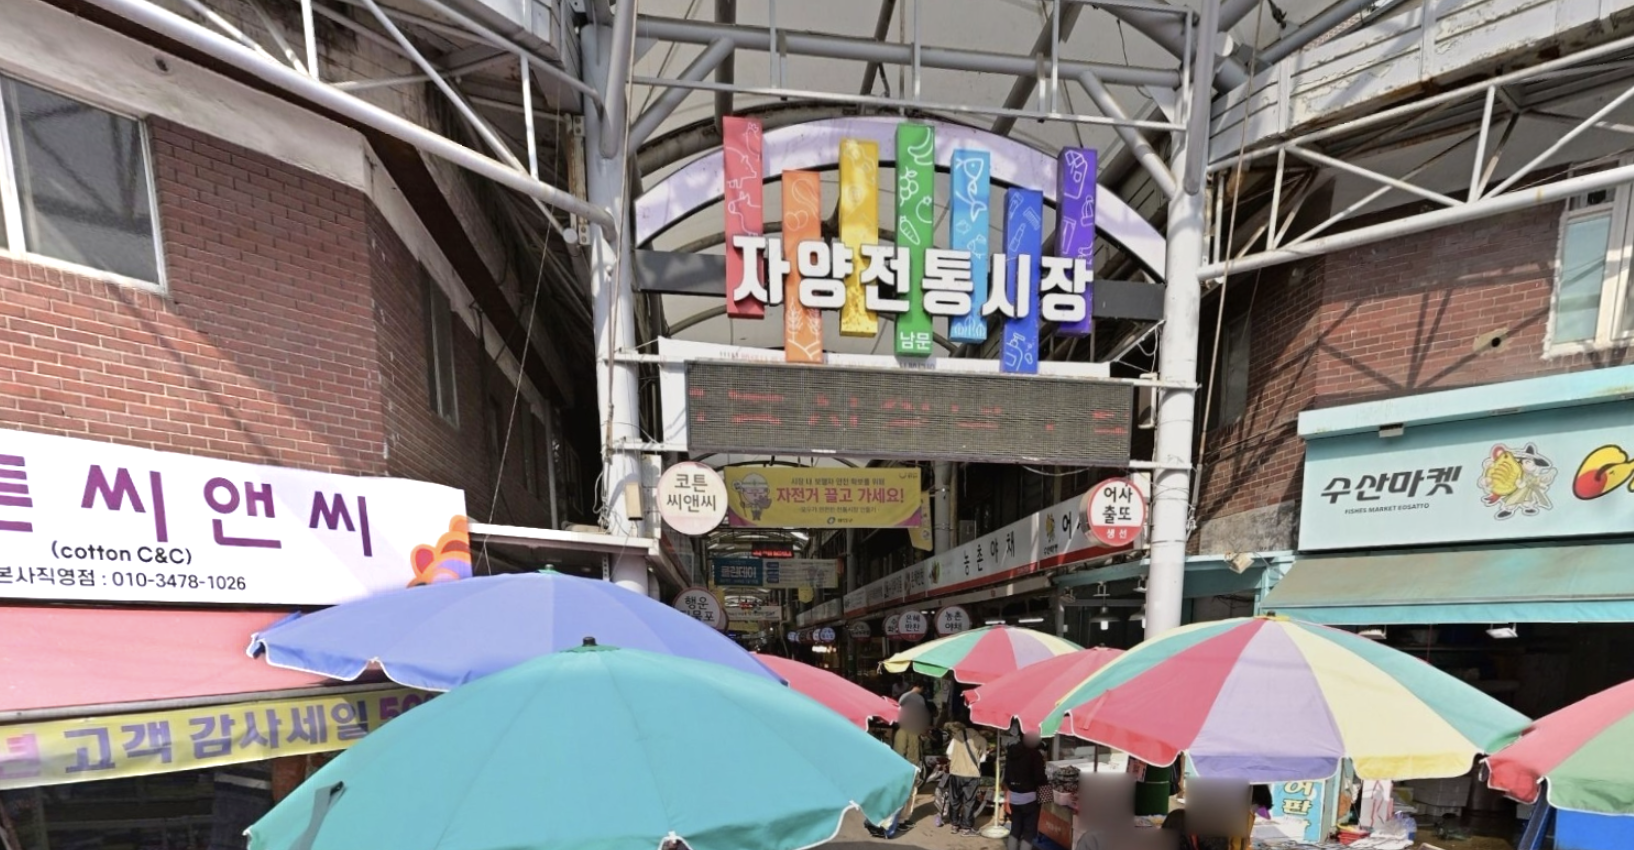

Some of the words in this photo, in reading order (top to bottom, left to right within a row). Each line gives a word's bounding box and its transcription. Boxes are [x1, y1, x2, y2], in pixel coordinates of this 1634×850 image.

[899, 331, 932, 350] 남문
[674, 474, 708, 493] 코튼
[1321, 465, 1463, 504] 수산마켓
[666, 494, 716, 512] 씨앤씨
[776, 487, 819, 503] 자전거
[824, 487, 853, 503] 끌고
[858, 487, 904, 503] 가세요!
[1104, 487, 1133, 503] 어사
[1102, 505, 1132, 524] 출또
[51, 541, 131, 562] (cotton
[137, 546, 192, 565] C&C)
[112, 572, 246, 591] 010-3478-1026
[685, 596, 708, 610] 행운
[946, 611, 963, 621] 농촌
[905, 623, 920, 632] 반찬
[64, 720, 173, 773] 고객
[188, 701, 369, 760] 감사세일
